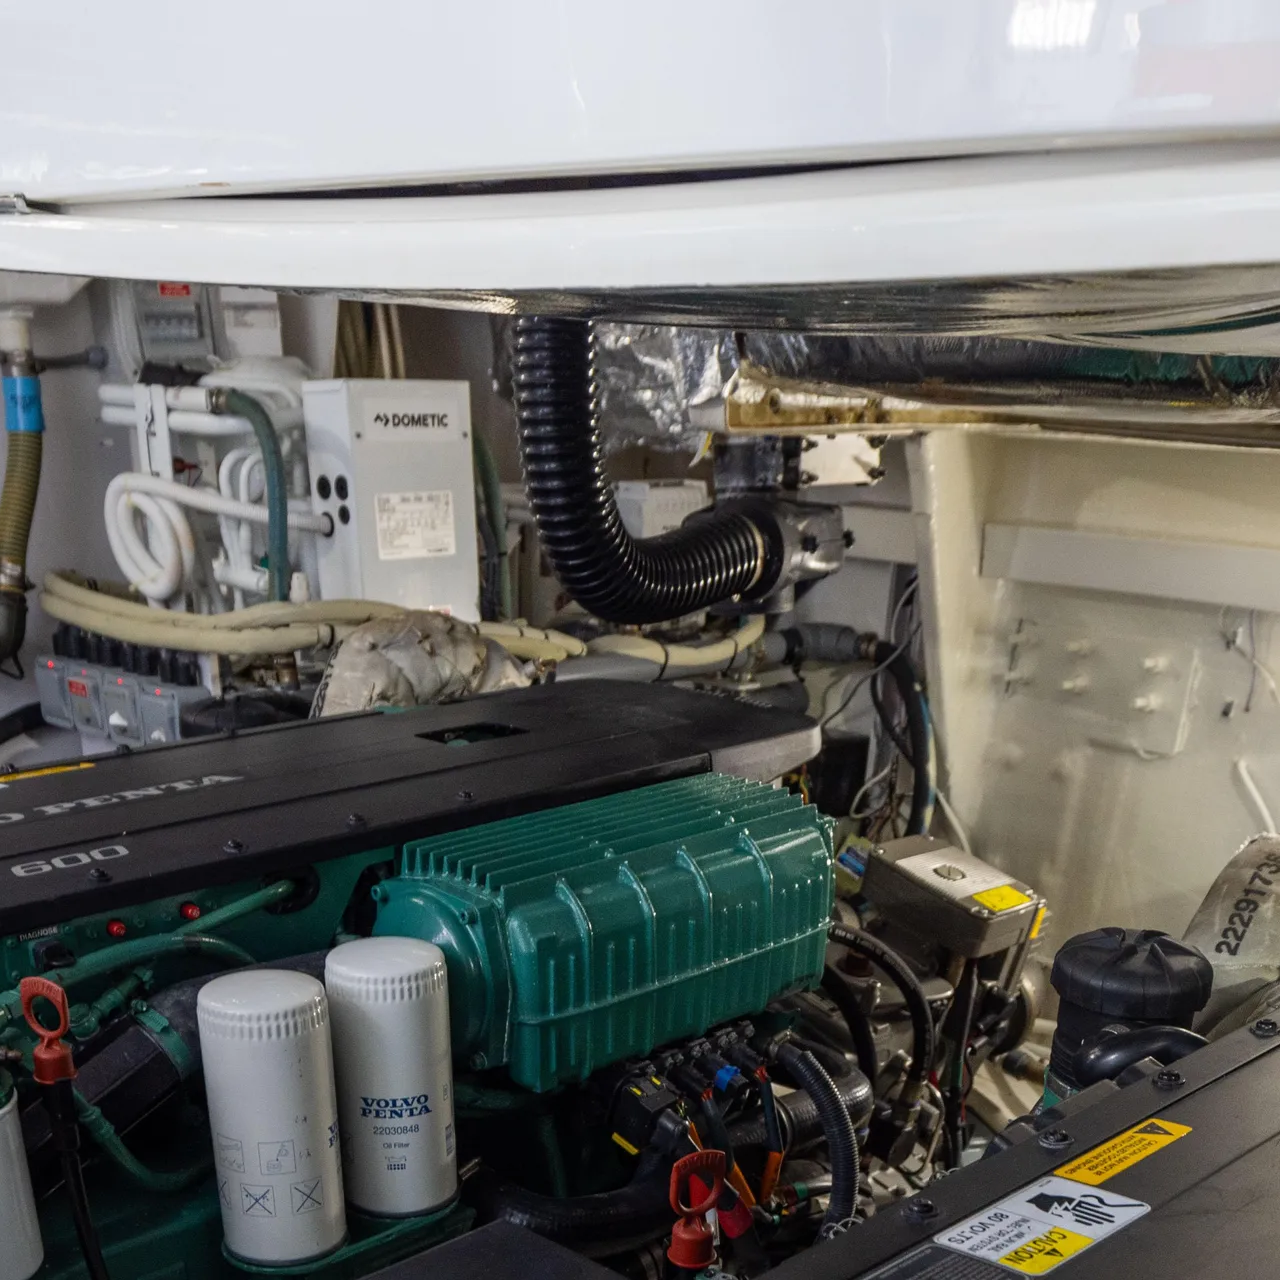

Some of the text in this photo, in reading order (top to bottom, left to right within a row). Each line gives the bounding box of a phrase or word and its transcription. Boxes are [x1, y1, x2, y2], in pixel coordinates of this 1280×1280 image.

[392, 413, 449, 428] DOMETIC
[30, 771, 246, 816] PENTA
[10, 843, 129, 878] 600
[360, 1094, 429, 1109] VOLVO
[360, 1104, 432, 1119] PENTA
[373, 1124, 420, 1136] 22030848
[985, 1211, 1011, 1223] 80
[1002, 1229, 1070, 1265] CAUTION
